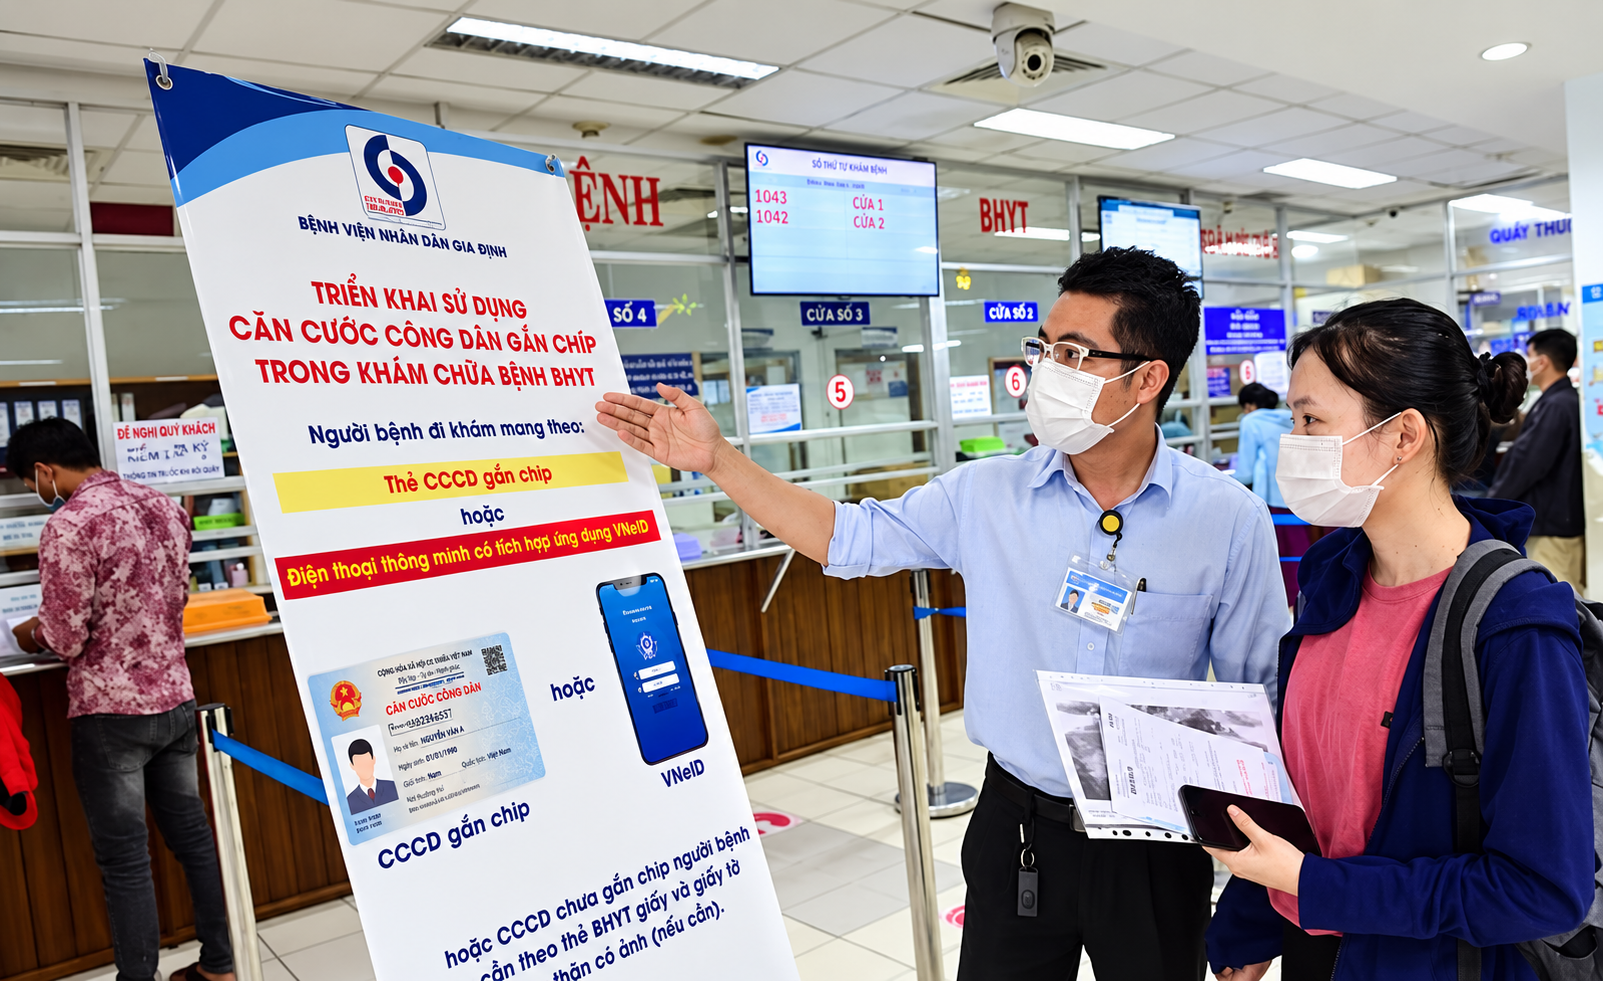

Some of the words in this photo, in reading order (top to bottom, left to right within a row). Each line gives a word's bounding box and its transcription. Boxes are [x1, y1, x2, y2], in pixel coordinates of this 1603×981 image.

[755, 189, 788, 205] 1043
[878, 199, 884, 211] 1
[979, 197, 1029, 234] BHYT
[756, 209, 789, 225] 1042
[878, 217, 885, 229] 2
[297, 214, 340, 235] BỆNH
[341, 221, 376, 242] VIỆN
[378, 227, 419, 246] NHÂN
[421, 232, 450, 251] DÂN
[452, 239, 476, 254] GIA
[477, 243, 508, 258] ĐỊNH
[310, 272, 378, 309] TRIỂN
[383, 287, 438, 313] KHAI
[441, 287, 468, 315] SỬ
[471, 295, 528, 323] DỤNG
[613, 301, 633, 323] SỐ
[637, 308, 647, 323] 4
[807, 304, 835, 322] CỬA
[837, 303, 853, 321] SỐ
[855, 308, 863, 321] 3
[989, 302, 1012, 320] CỬA
[1012, 302, 1026, 319] SỐ
[1027, 307, 1034, 319] 2
[228, 310, 294, 343] CĂN
[300, 315, 379, 346] CƯỚC
[384, 319, 454, 351] CÔNG
[458, 320, 502, 353] DÂN
[506, 322, 548, 355] GẮN
[552, 329, 597, 354] CHÍP
[254, 358, 351, 385] TRONG
[356, 355, 429, 385] KHÁM
[433, 358, 494, 387] CHỮA
[497, 360, 548, 392] BỆNH
[549, 367, 595, 387] BHYT
[1011, 372, 1020, 391] 6
[835, 381, 846, 402] 5
[307, 422, 371, 449] Người
[373, 421, 424, 446] bệnh
[428, 421, 446, 440] đi
[448, 419, 497, 439] khám
[499, 422, 546, 440] mang
[546, 418, 585, 435] theo:
[383, 470, 419, 494] Thẻ
[423, 469, 479, 491] CCCD
[482, 462, 516, 491] gắn
[518, 464, 553, 485] chip
[460, 504, 505, 528] hoặc
[286, 564, 330, 589] Điện
[332, 557, 378, 581] thoại
[380, 552, 430, 573] thông
[432, 545, 471, 566] minh
[474, 540, 493, 559] có
[495, 537, 523, 556] tích
[523, 534, 551, 554] hợp
[553, 527, 579, 548] ứng
[580, 527, 613, 545] dụng
[612, 519, 649, 537] VNeID
[549, 675, 596, 702] hoặc
[660, 759, 705, 788] VNeID
[378, 831, 442, 869] CCCD
[447, 813, 487, 849] gắn
[490, 801, 530, 828] chip
[444, 937, 493, 969] hoặc
[496, 909, 551, 946] CCCD
[556, 891, 599, 920] chưa
[602, 872, 635, 905] gắn
[637, 861, 670, 885] chip
[672, 842, 714, 873] người
[714, 826, 751, 853] bệnh
[518, 943, 558, 972] theo
[560, 923, 589, 952] thẻ
[591, 905, 631, 938] BHYT
[635, 887, 669, 923] giấy
[671, 880, 691, 902] và
[693, 865, 723, 897] giấy
[725, 858, 741, 878] tờ
[595, 945, 615, 970] có
[618, 933, 648, 959] ảnh
[651, 914, 685, 948] (nếu
[687, 900, 725, 928] cần).
